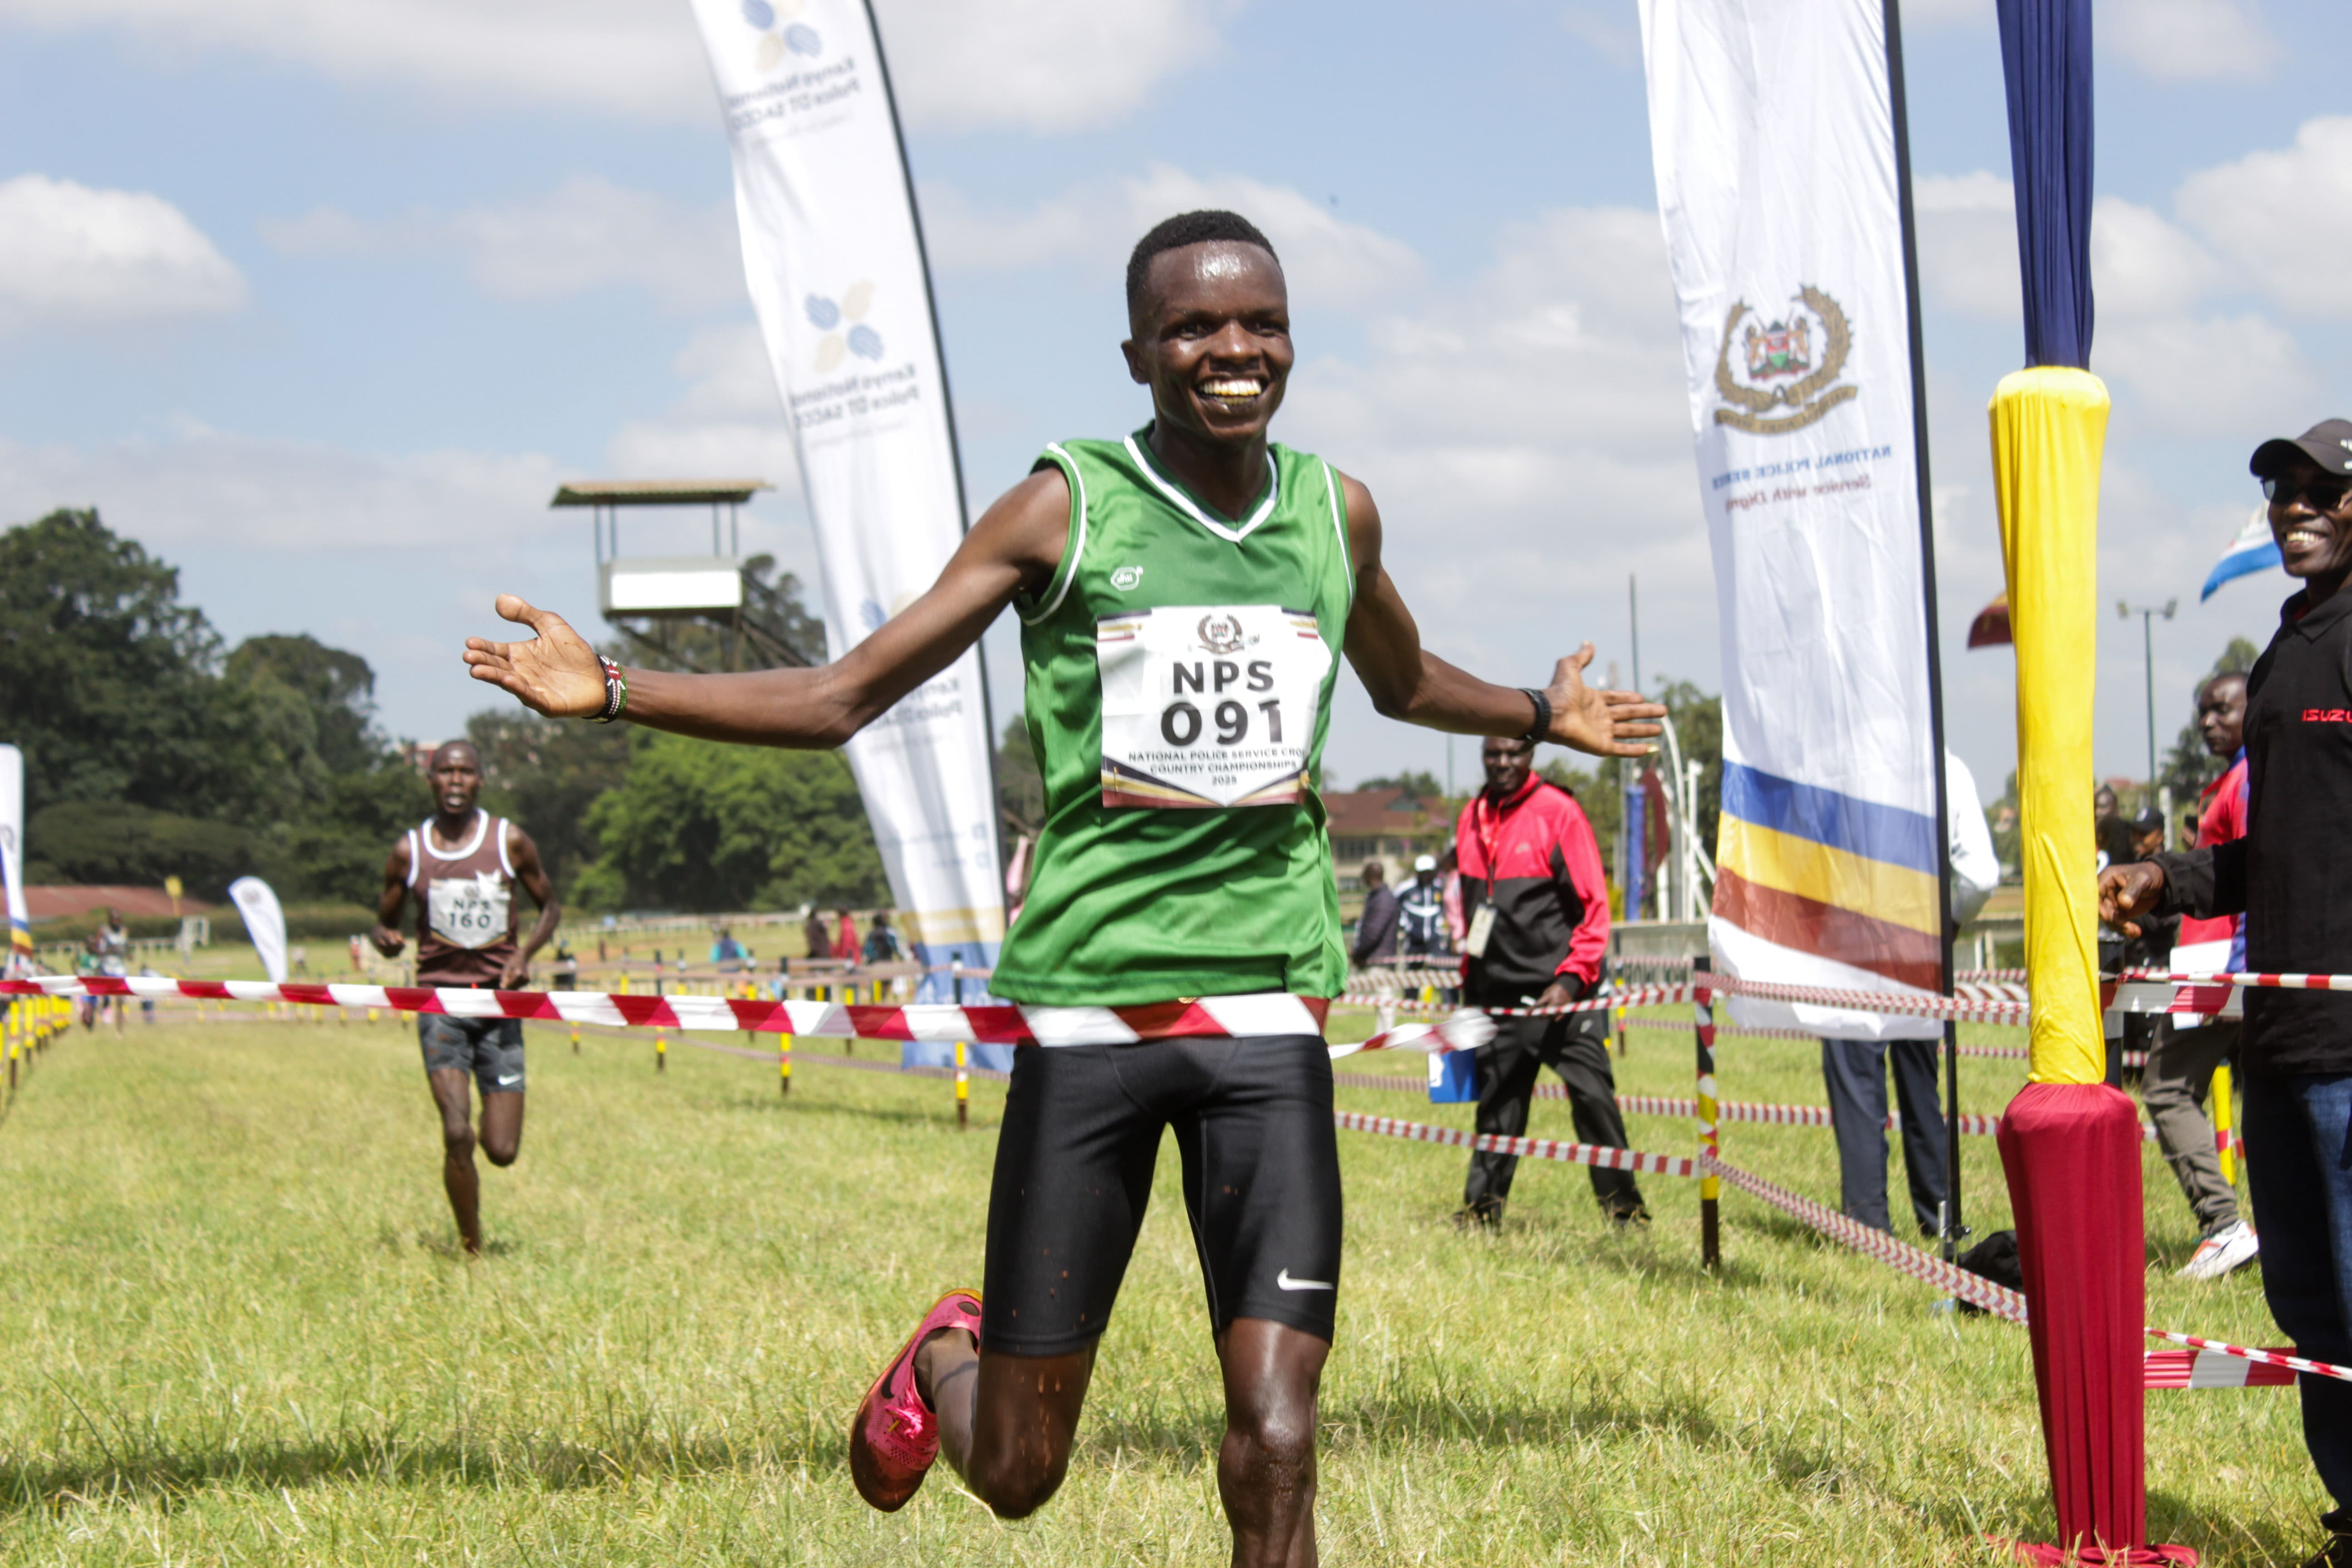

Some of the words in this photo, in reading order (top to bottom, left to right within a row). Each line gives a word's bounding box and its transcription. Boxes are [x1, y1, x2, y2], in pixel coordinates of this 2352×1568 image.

[1173, 660, 1274, 694] NPS
[1160, 699, 1282, 747] 091
[1129, 751, 1186, 762] NATIONAL
[1190, 749, 1228, 761] POLICE
[1232, 748, 1277, 760] SERVICE
[1150, 763, 1203, 774] COUNTRY
[1208, 759, 1297, 773] CHAMPIONSHIPS
[454, 899, 490, 911] NPS
[449, 913, 491, 929] 160
